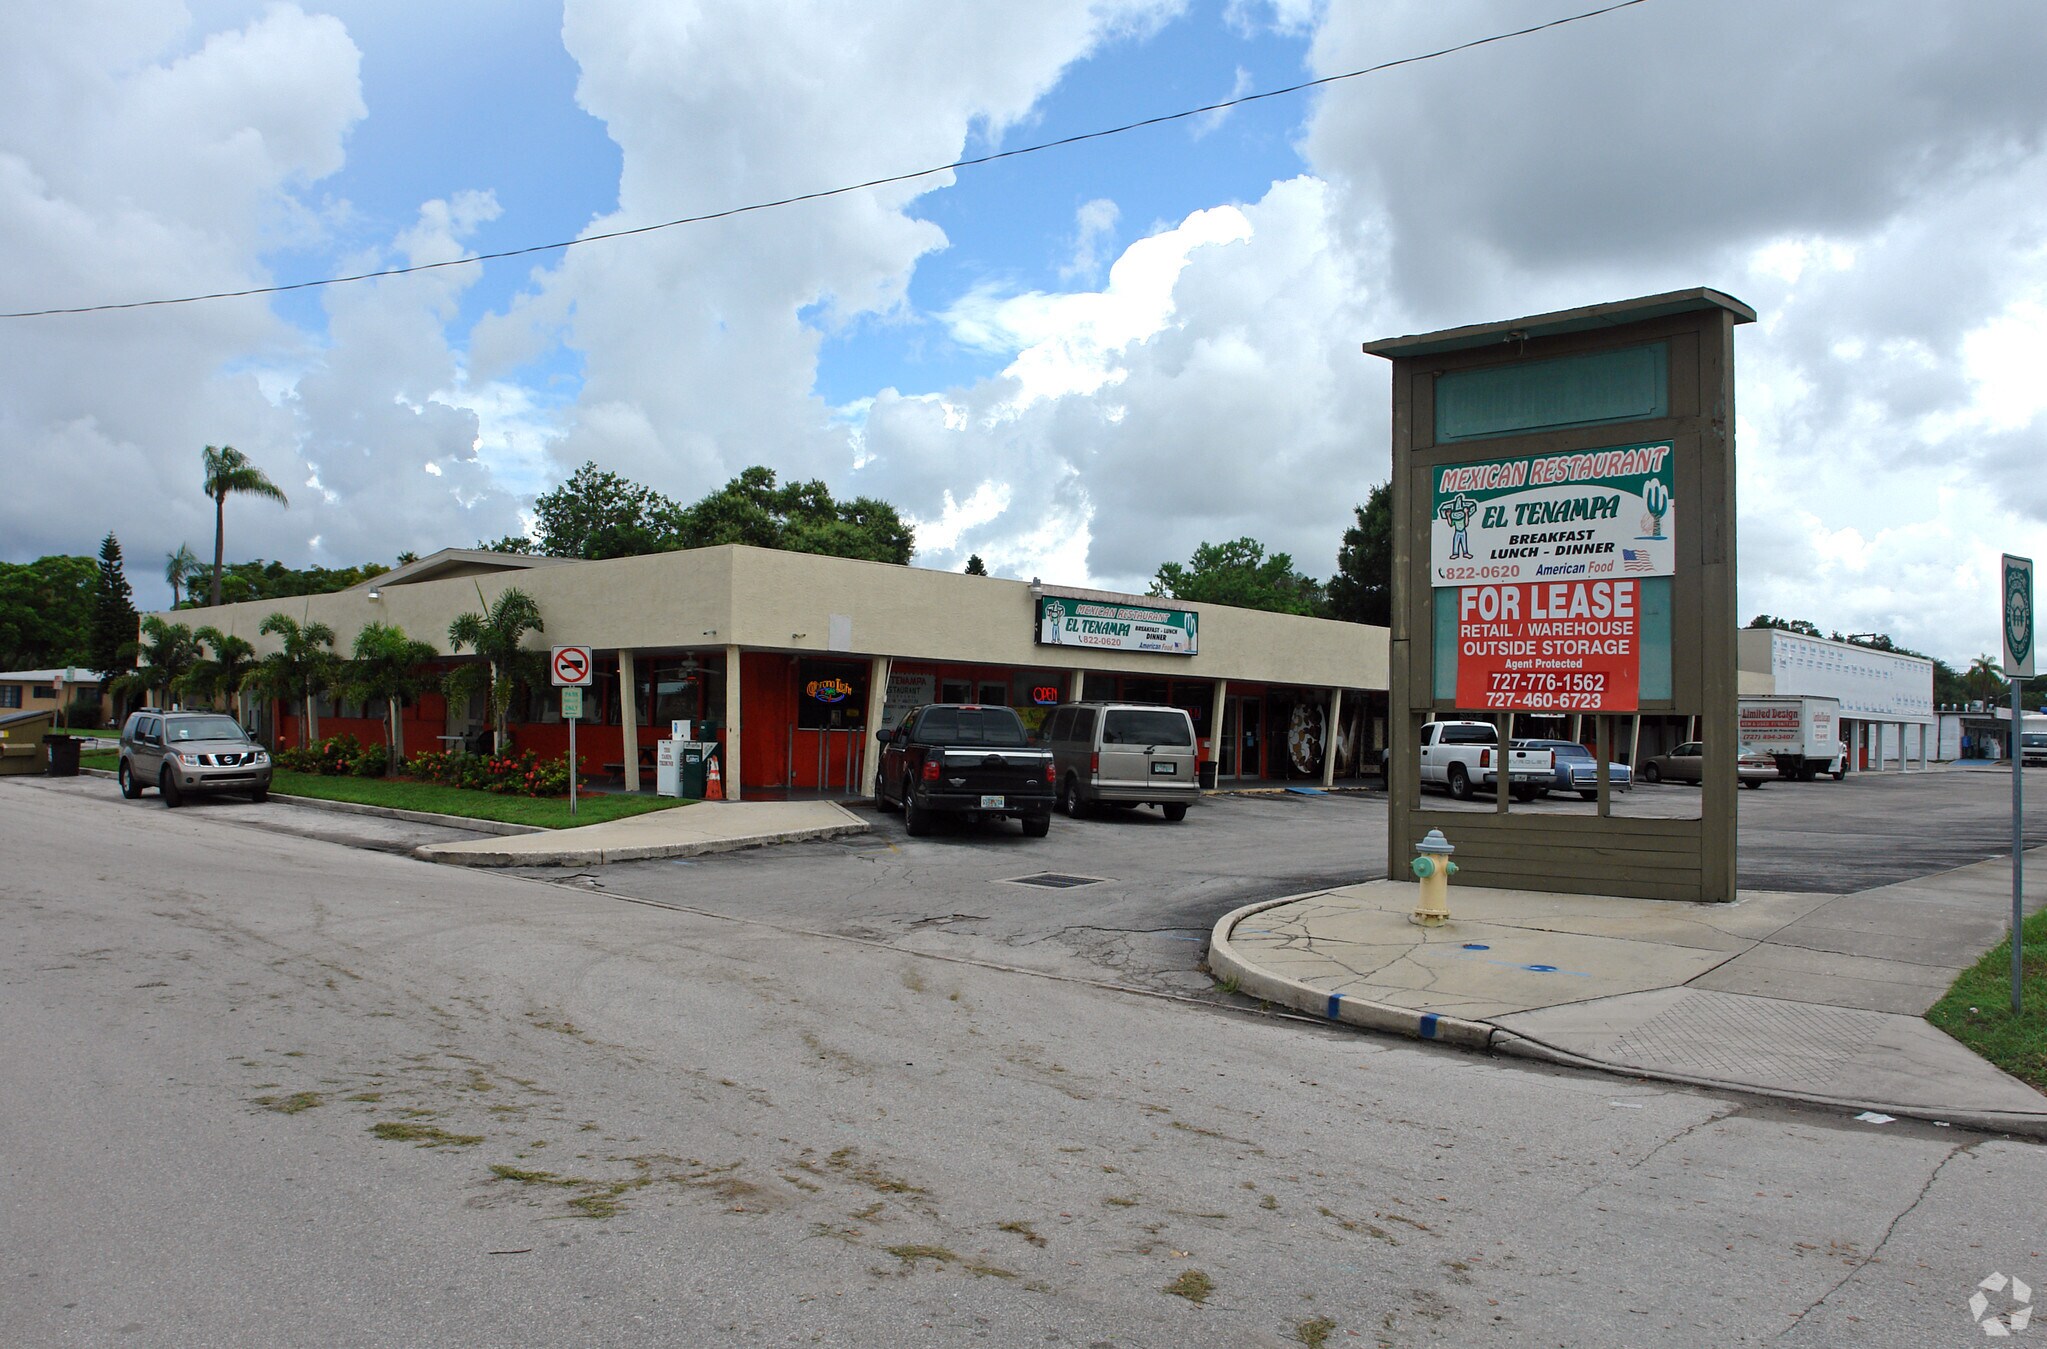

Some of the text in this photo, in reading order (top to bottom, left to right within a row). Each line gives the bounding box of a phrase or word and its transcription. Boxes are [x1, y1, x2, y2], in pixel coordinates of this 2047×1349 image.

[1440, 446, 1669, 493] MEXICAN RESTAURANT
[1481, 494, 1620, 529] EL TENAMPA
[1509, 529, 1595, 545] BREAKFAST
[1490, 546, 1538, 560] LUNCH
[1555, 542, 1615, 556] DINNER
[1446, 560, 1614, 580] 822-0620 American Food
[1461, 582, 1634, 621] FOR LEASE
[1076, 604, 1170, 622] MEXICAN RESTAURANT
[1065, 618, 1131, 636] EL TENAMPA
[1460, 624, 1513, 638] RETAIL
[1528, 621, 1634, 636] WAREHOUSE
[1083, 636, 1121, 646] 822-0620
[1138, 642, 1162, 650] American
[1146, 632, 1167, 641] DINNER
[1464, 640, 1630, 656] OUTSIDE STORAGE
[1505, 658, 1582, 669] Agent Protected
[1492, 673, 1605, 692] 727-776-1562
[1033, 686, 1058, 702] OPEN
[1486, 692, 1602, 708] 727-460-6723
[1742, 708, 1798, 720] Limited Design
